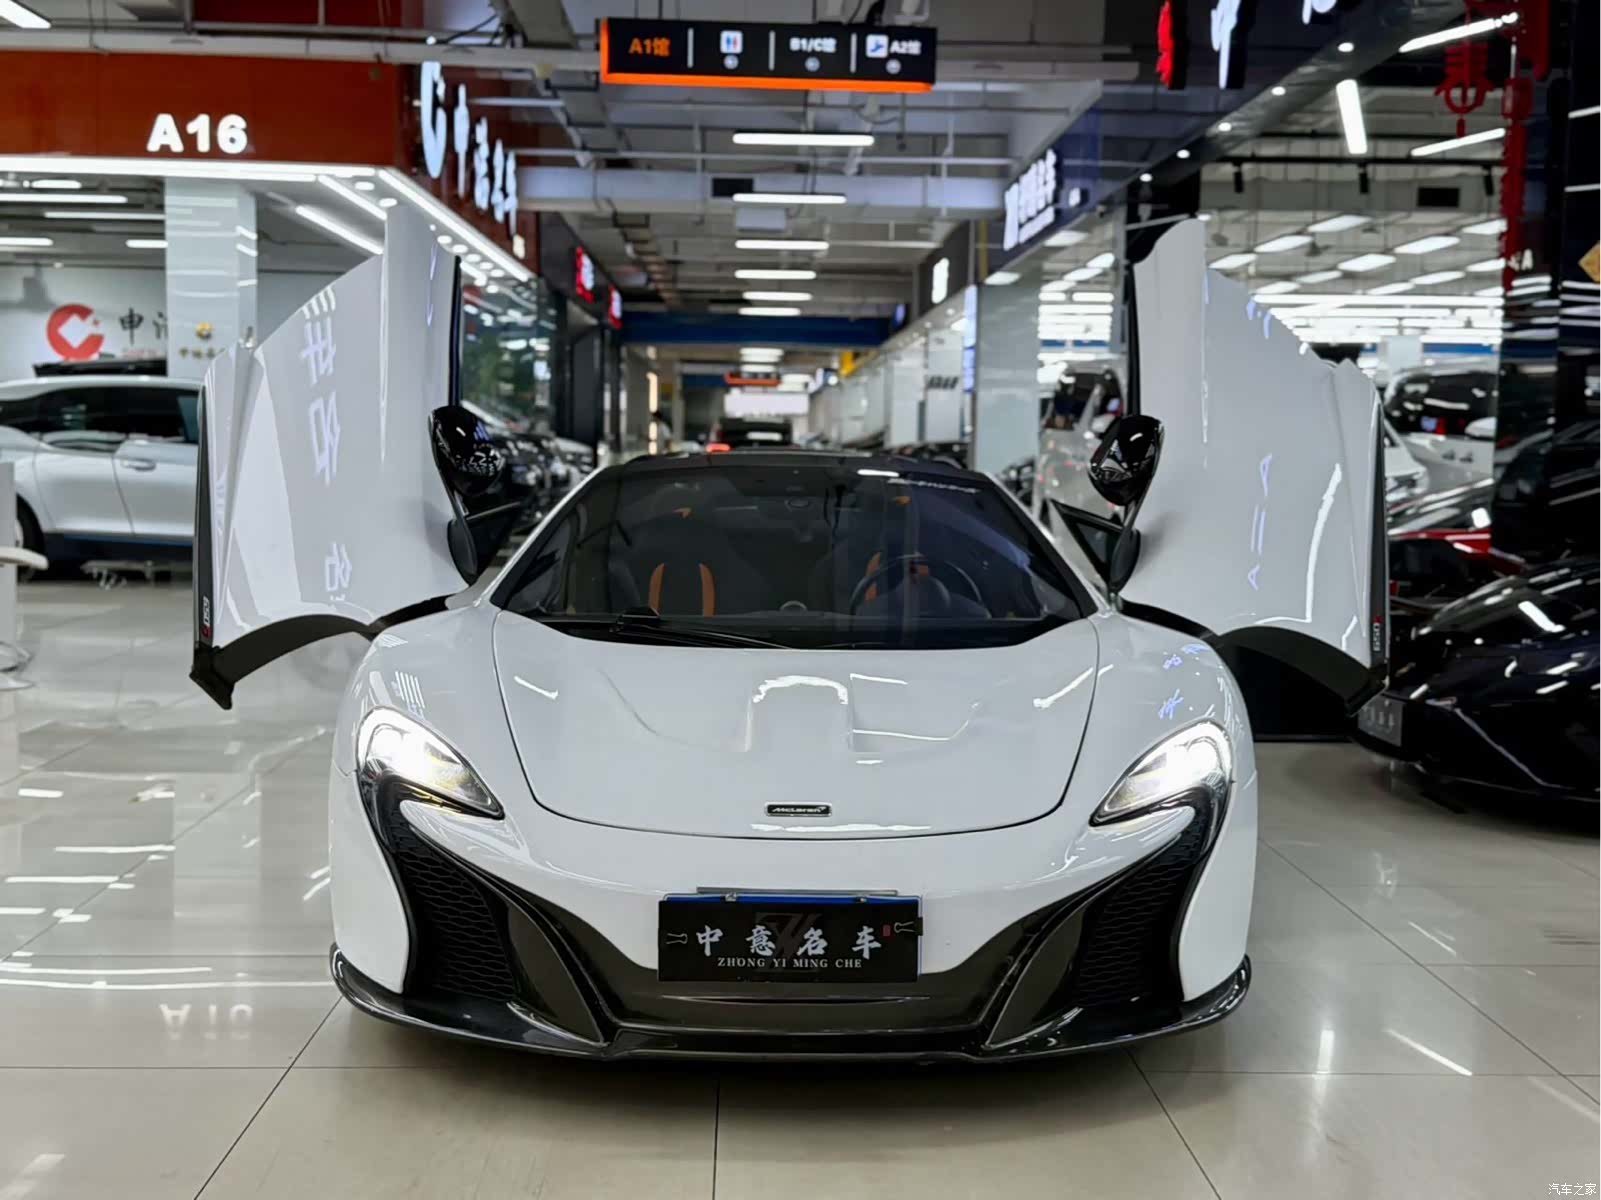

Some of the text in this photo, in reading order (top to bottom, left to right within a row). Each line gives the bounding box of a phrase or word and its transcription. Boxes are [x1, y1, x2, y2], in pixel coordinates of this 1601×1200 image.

[146, 113, 248, 154] A16
[696, 924, 882, 960] 中意名车
[717, 957, 862, 968] ZHONG YI MING CHE
